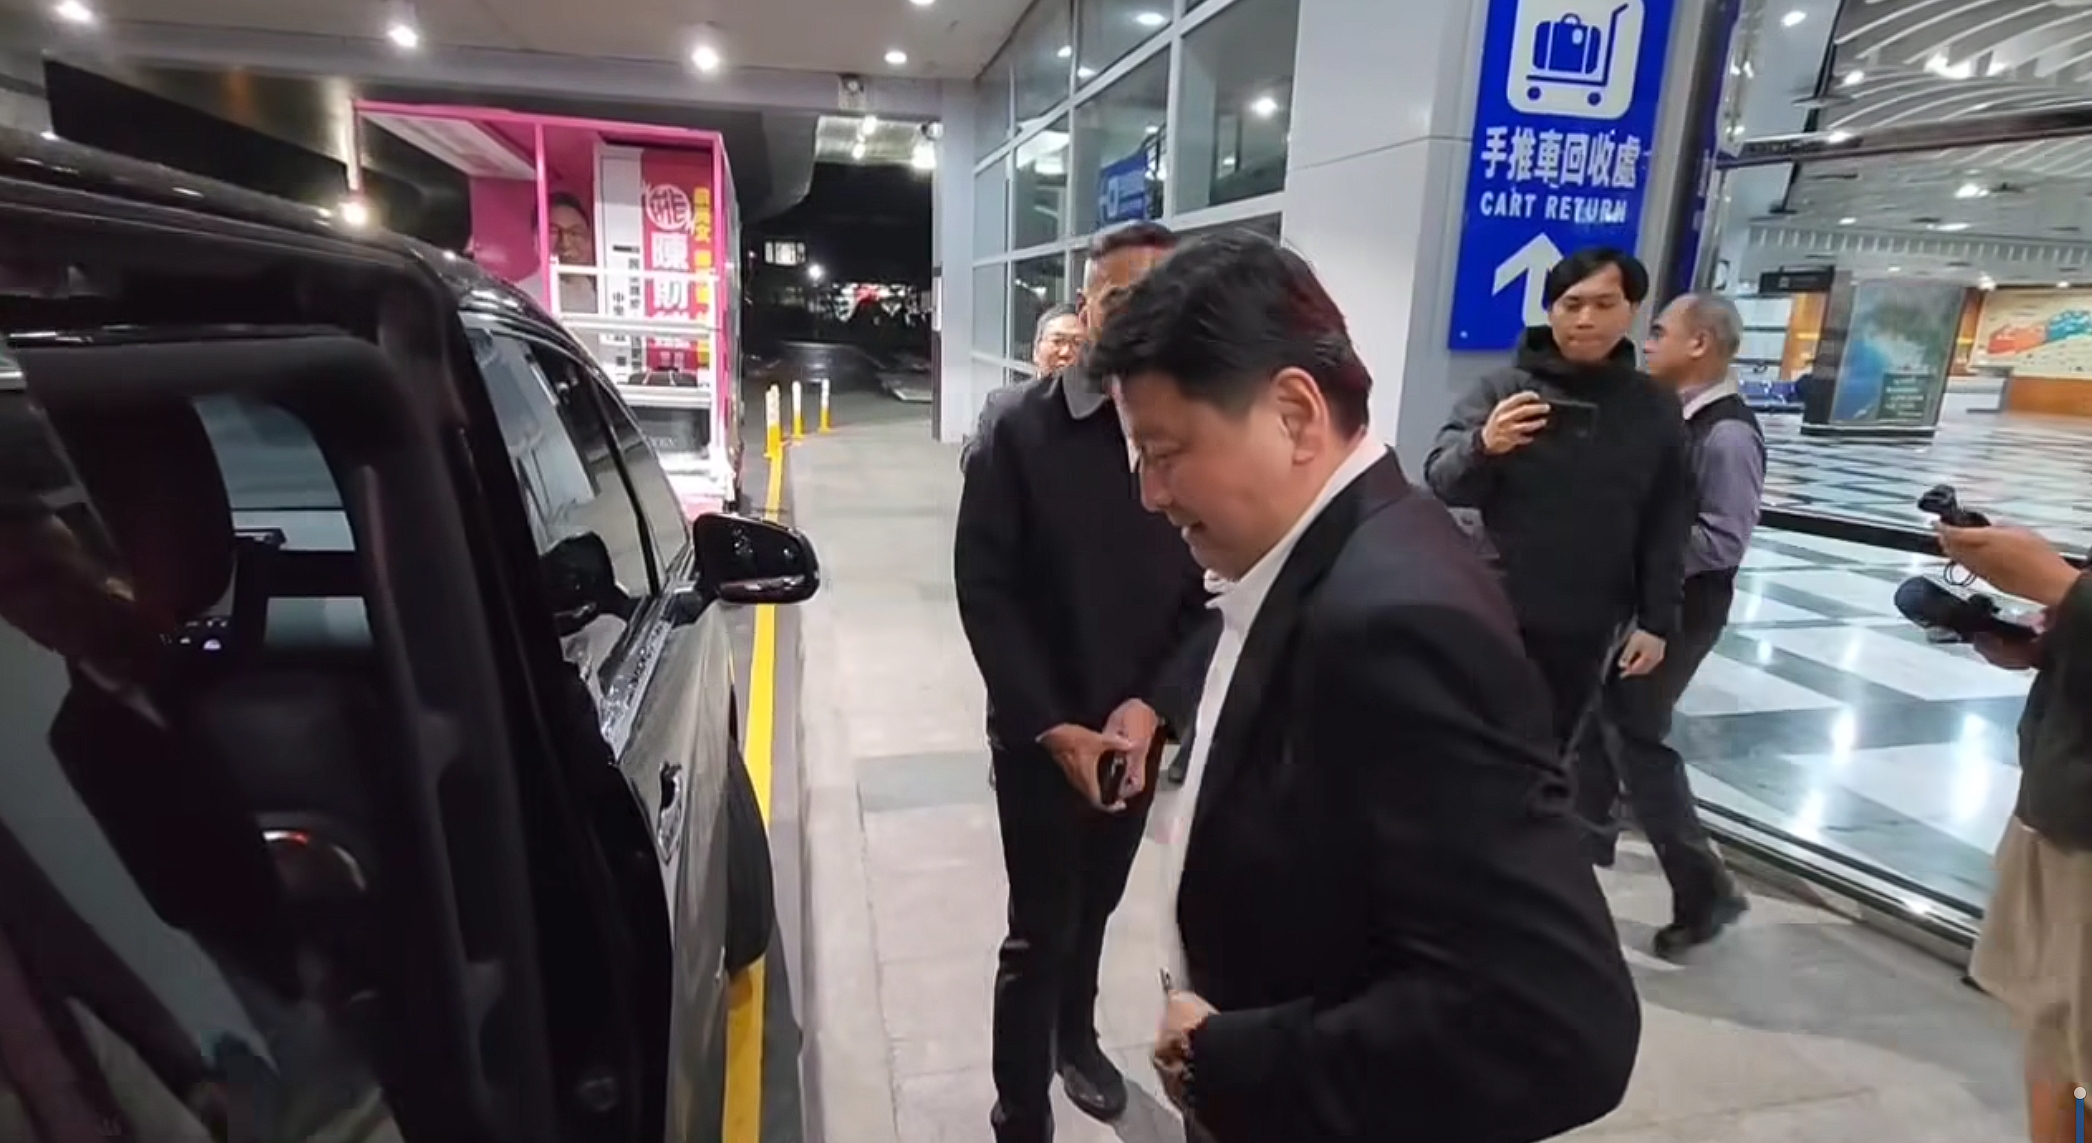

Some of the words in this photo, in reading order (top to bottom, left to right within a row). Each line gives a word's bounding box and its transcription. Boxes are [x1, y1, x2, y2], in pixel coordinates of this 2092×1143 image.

[1479, 126, 1641, 188] 手推車回收處
[1481, 191, 1537, 218] CART
[1545, 195, 1628, 223] RETURN
